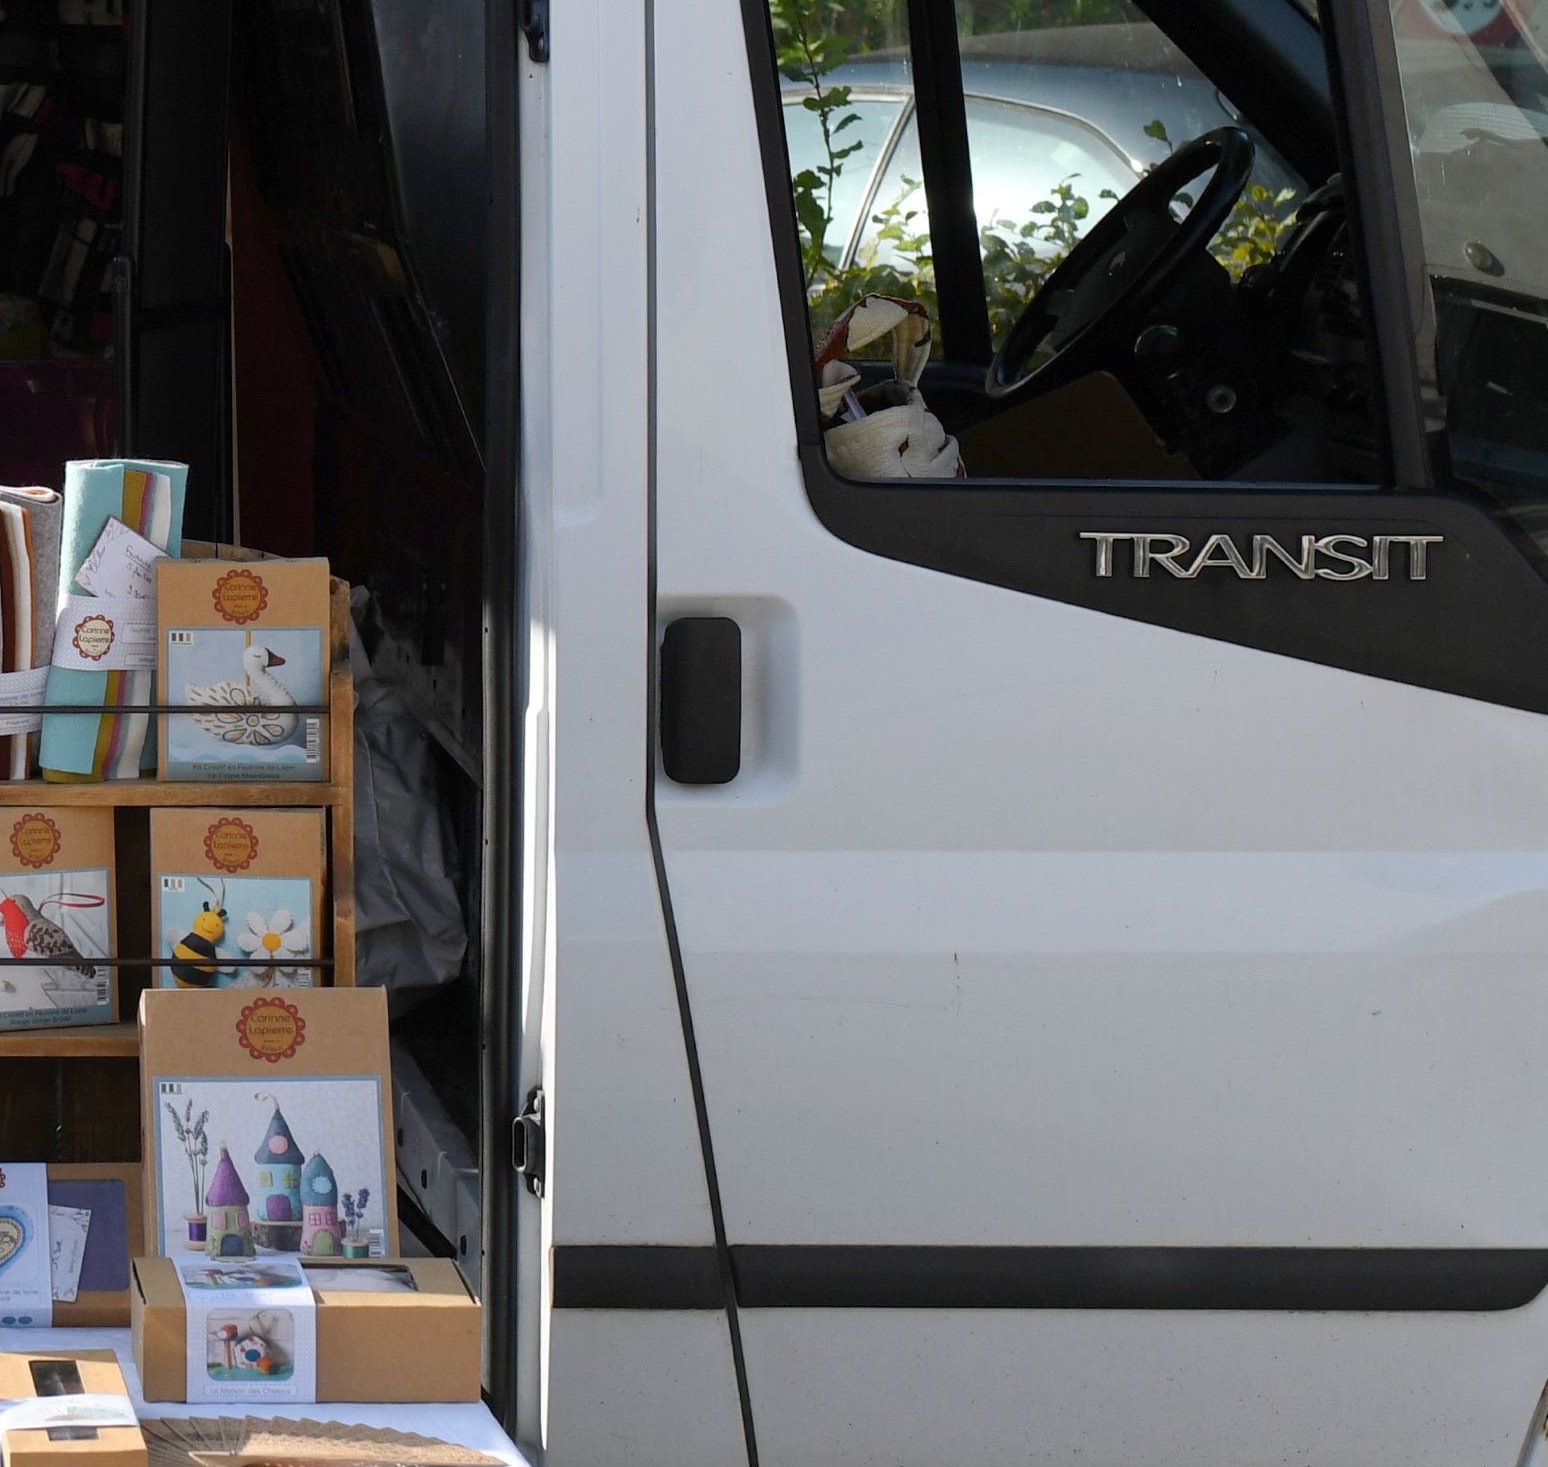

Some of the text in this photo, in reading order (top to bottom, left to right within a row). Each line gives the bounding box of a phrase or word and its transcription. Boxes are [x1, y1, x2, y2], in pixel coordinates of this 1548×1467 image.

[1079, 532, 1445, 581] TRANSIT
[250, 1013, 291, 1023] Corinne
[249, 1024, 293, 1036] Lapierre
